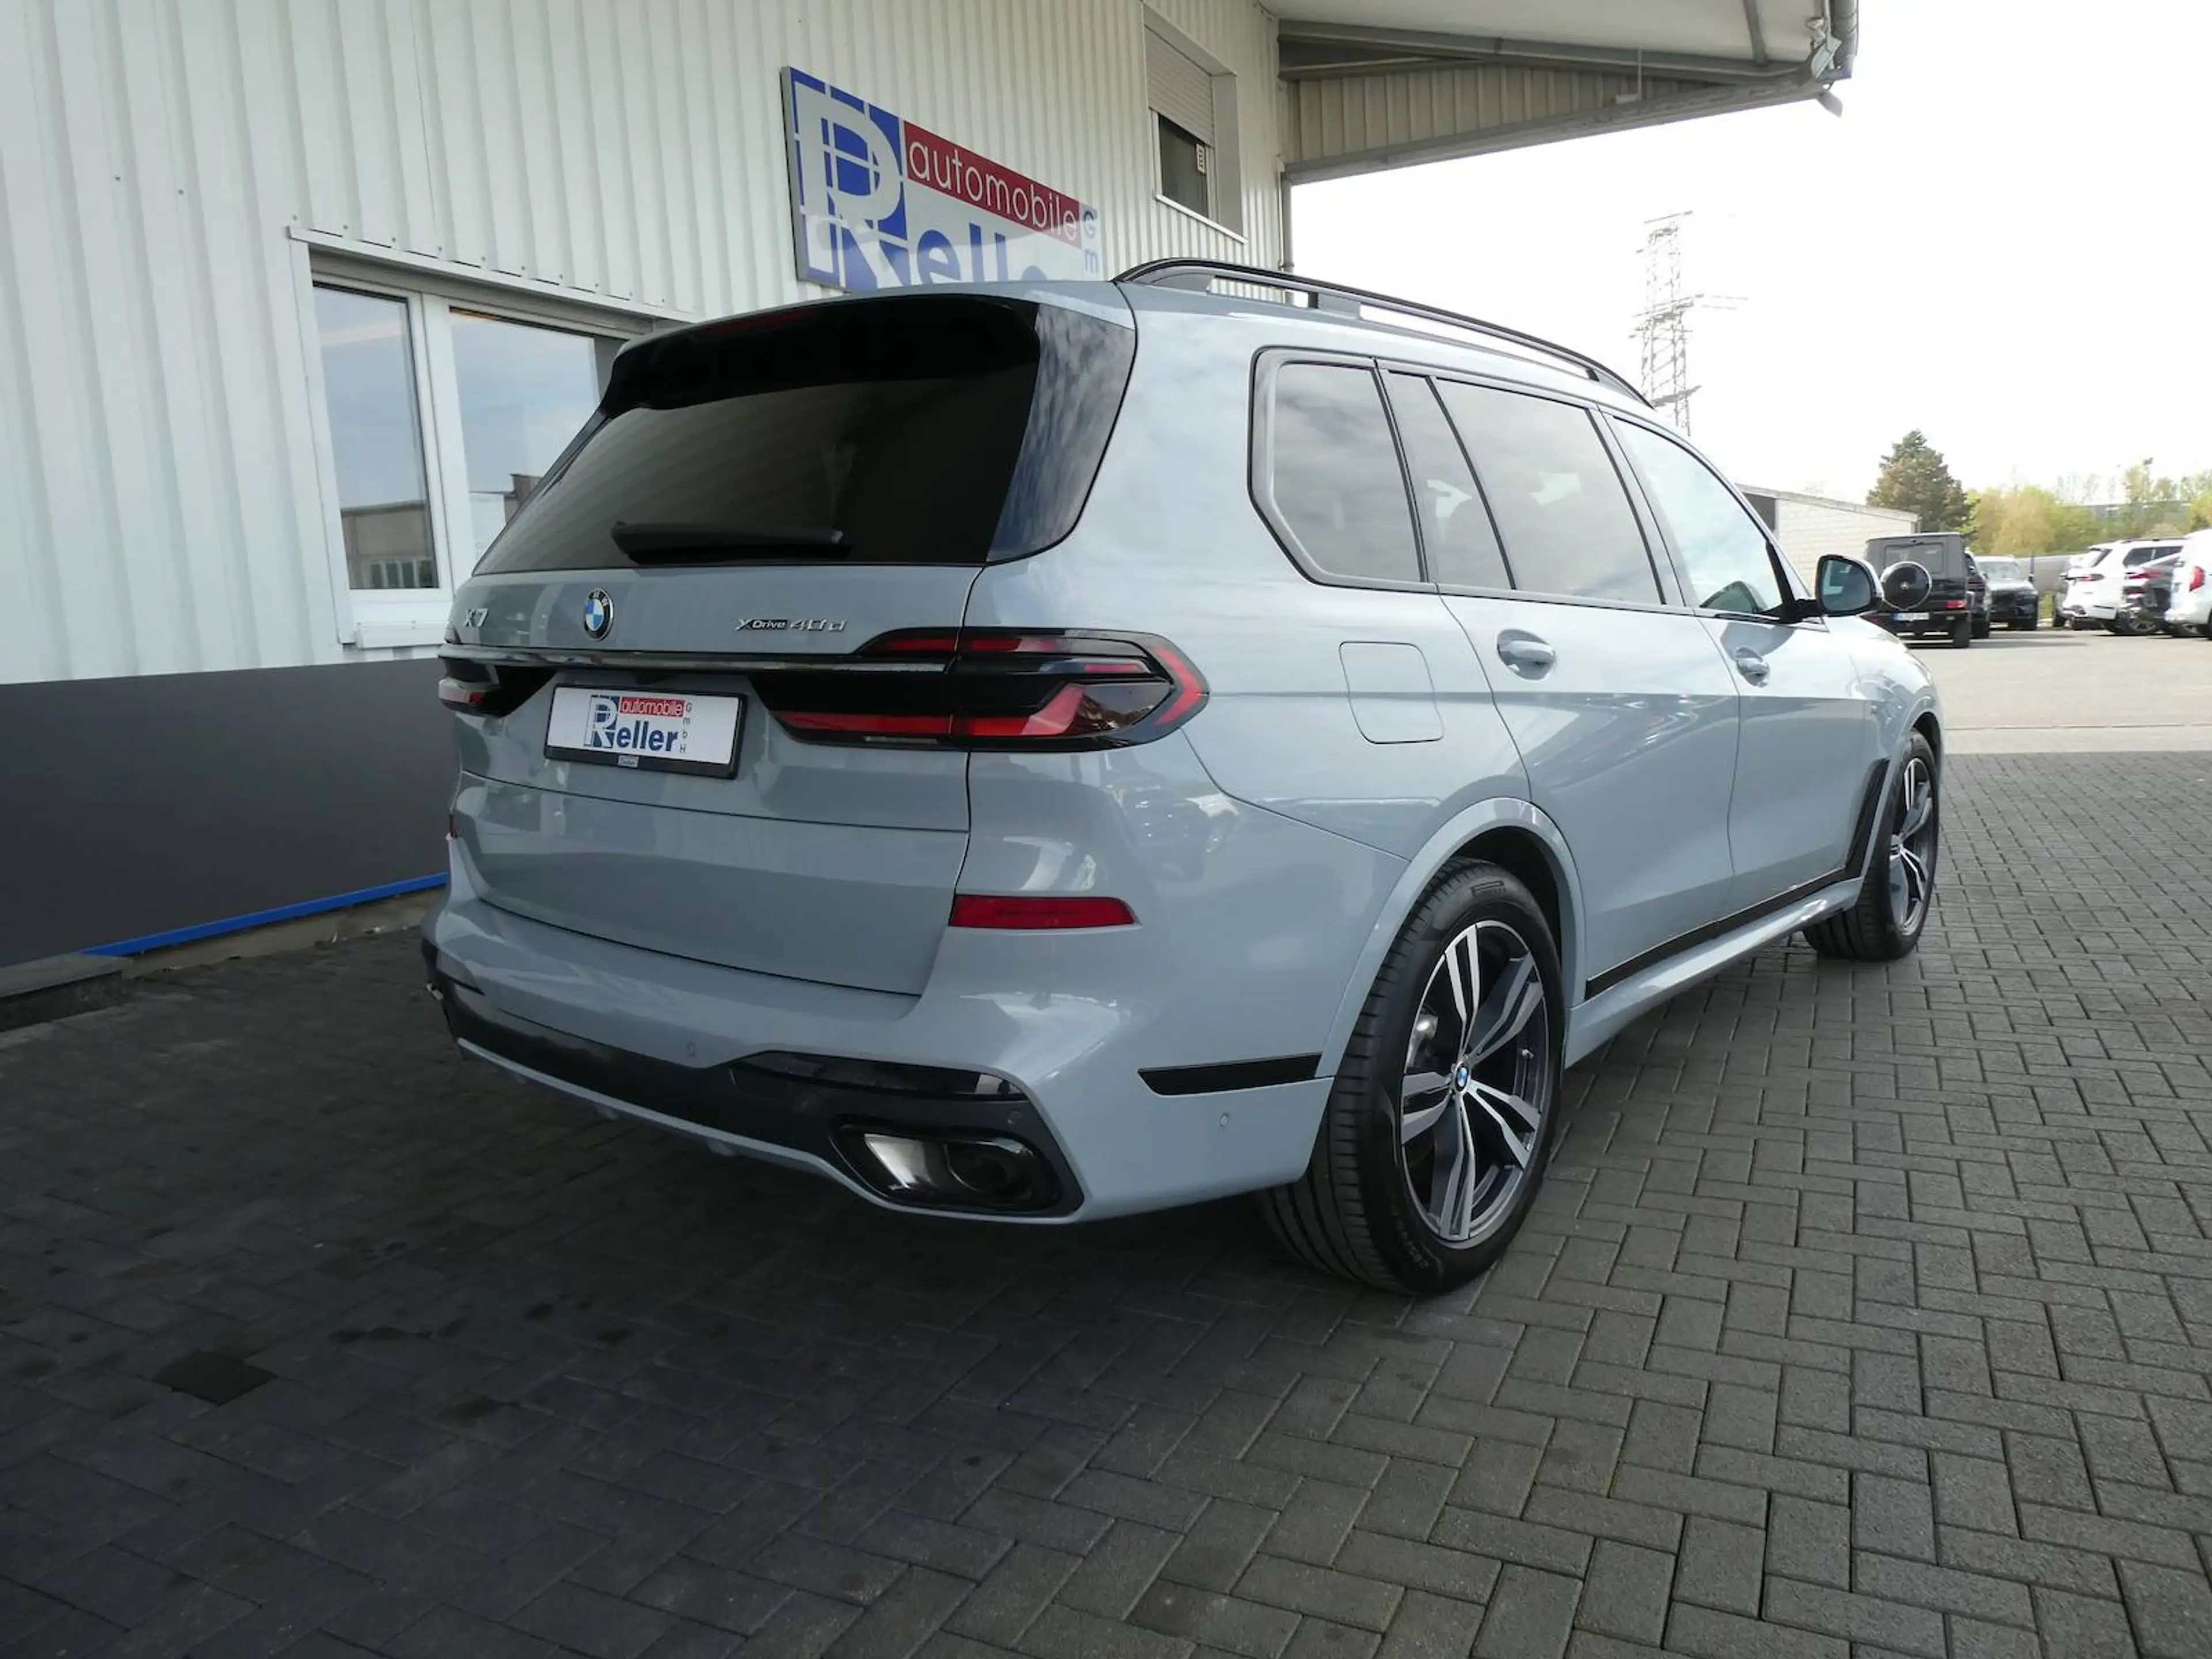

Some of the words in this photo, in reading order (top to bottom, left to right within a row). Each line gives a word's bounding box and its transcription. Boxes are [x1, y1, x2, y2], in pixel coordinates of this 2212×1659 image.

[908, 140, 1077, 240] automobile
[463, 608, 488, 627] X7
[583, 694, 679, 751] Reller
[622, 699, 683, 716] automobile
